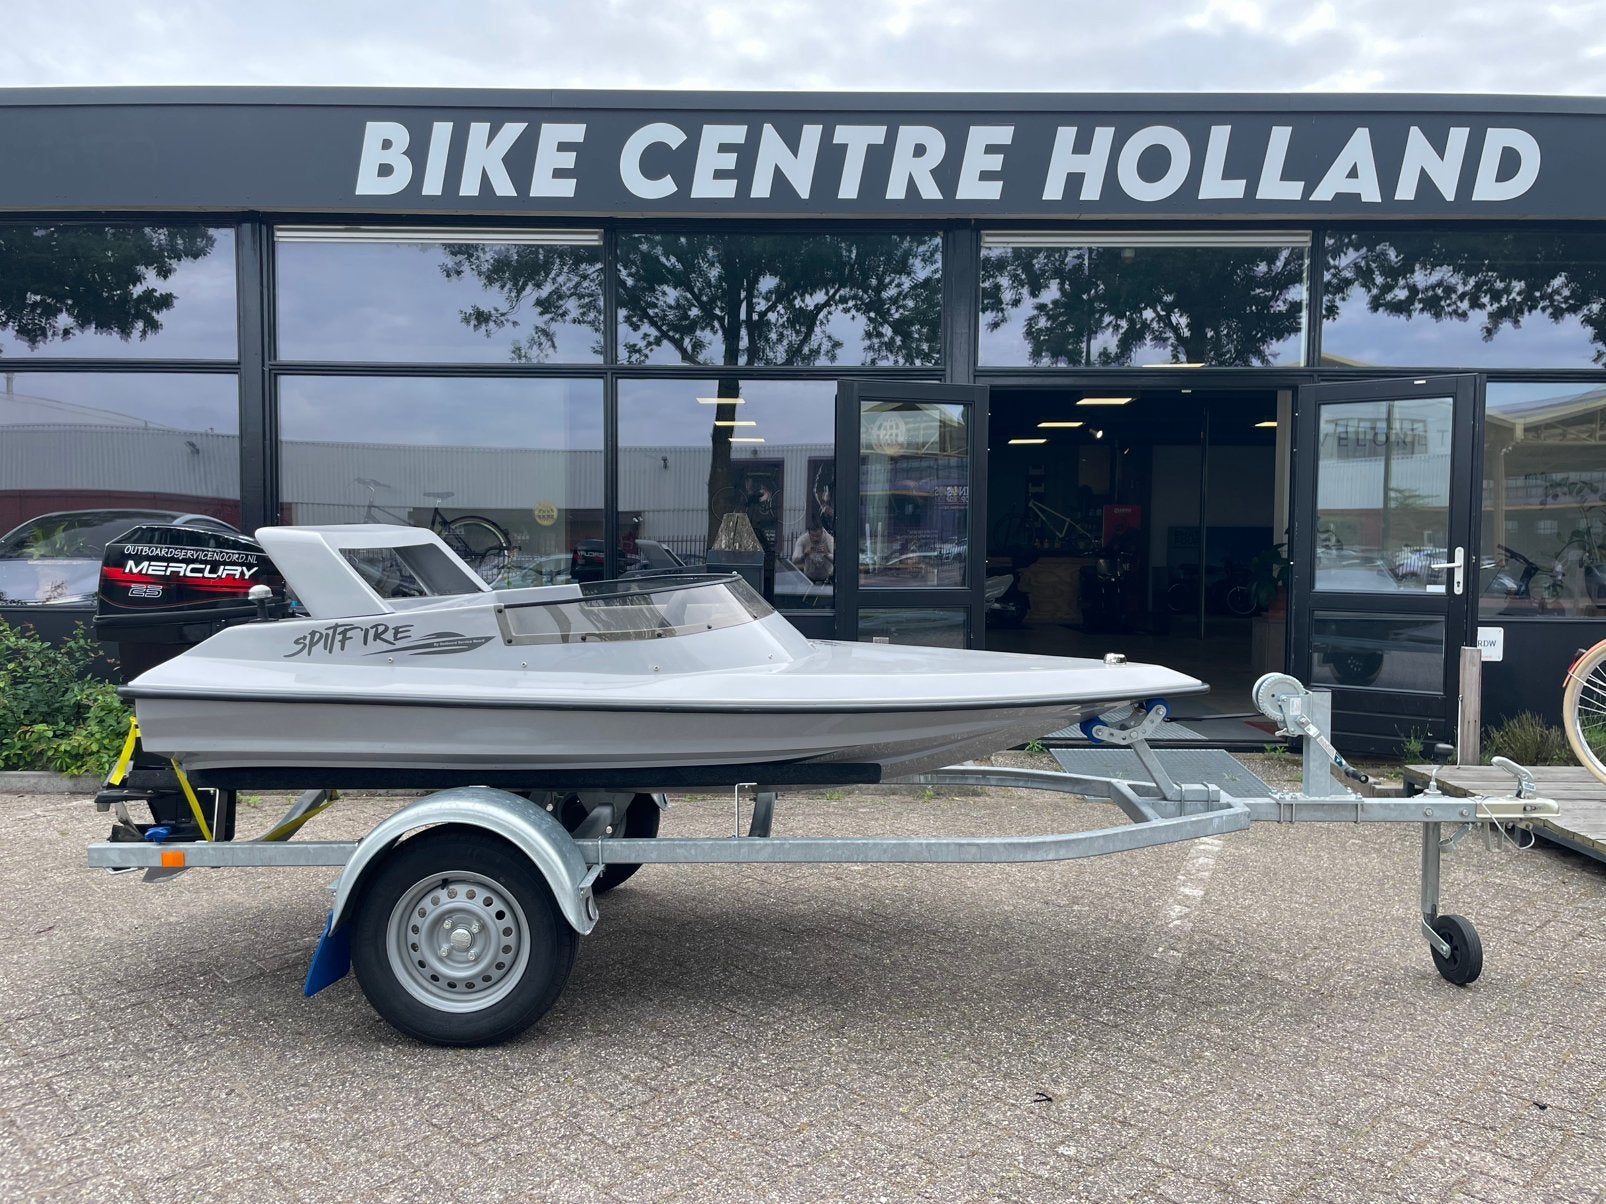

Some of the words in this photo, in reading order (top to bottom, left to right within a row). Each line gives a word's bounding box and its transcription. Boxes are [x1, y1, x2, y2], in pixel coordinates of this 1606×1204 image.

[355, 121, 587, 198] BIKE
[619, 122, 1015, 201] CENTRE
[1042, 125, 1541, 203] HOLLAND
[124, 544, 258, 564] OUTBOARDSERVICENOORD.NL
[124, 560, 259, 579] MERCURY
[128, 584, 163, 598] 25
[283, 623, 414, 658] SPITFIRE
[1477, 639, 1497, 647] RDW
